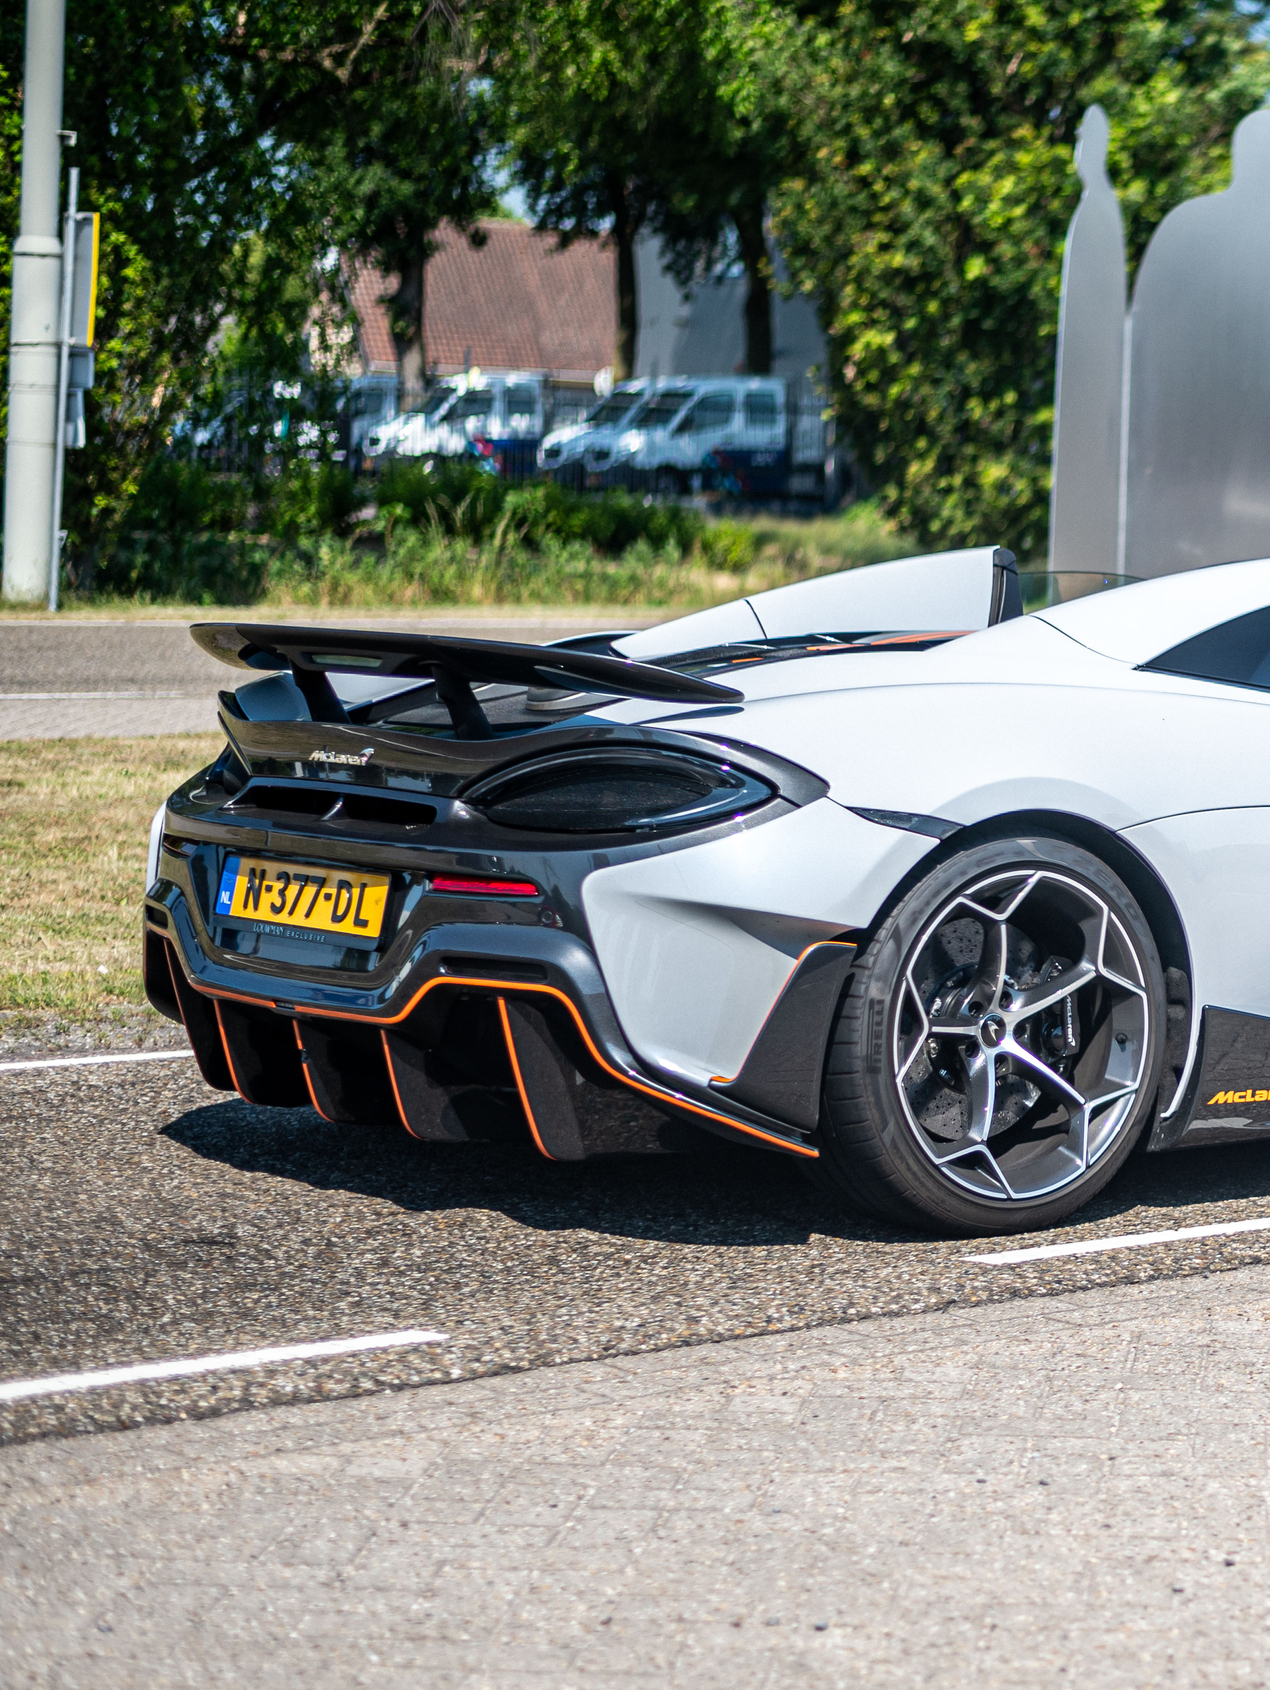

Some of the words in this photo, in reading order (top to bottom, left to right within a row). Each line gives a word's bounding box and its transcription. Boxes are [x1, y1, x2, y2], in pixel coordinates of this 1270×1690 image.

[309, 750, 370, 766] McLaren
[220, 891, 231, 905] NL
[243, 867, 369, 927] N-377-DL
[253, 922, 284, 936] LOUWMAN
[286, 930, 326, 942] EXCLUSIVE
[866, 997, 885, 1075] PIRELLI
